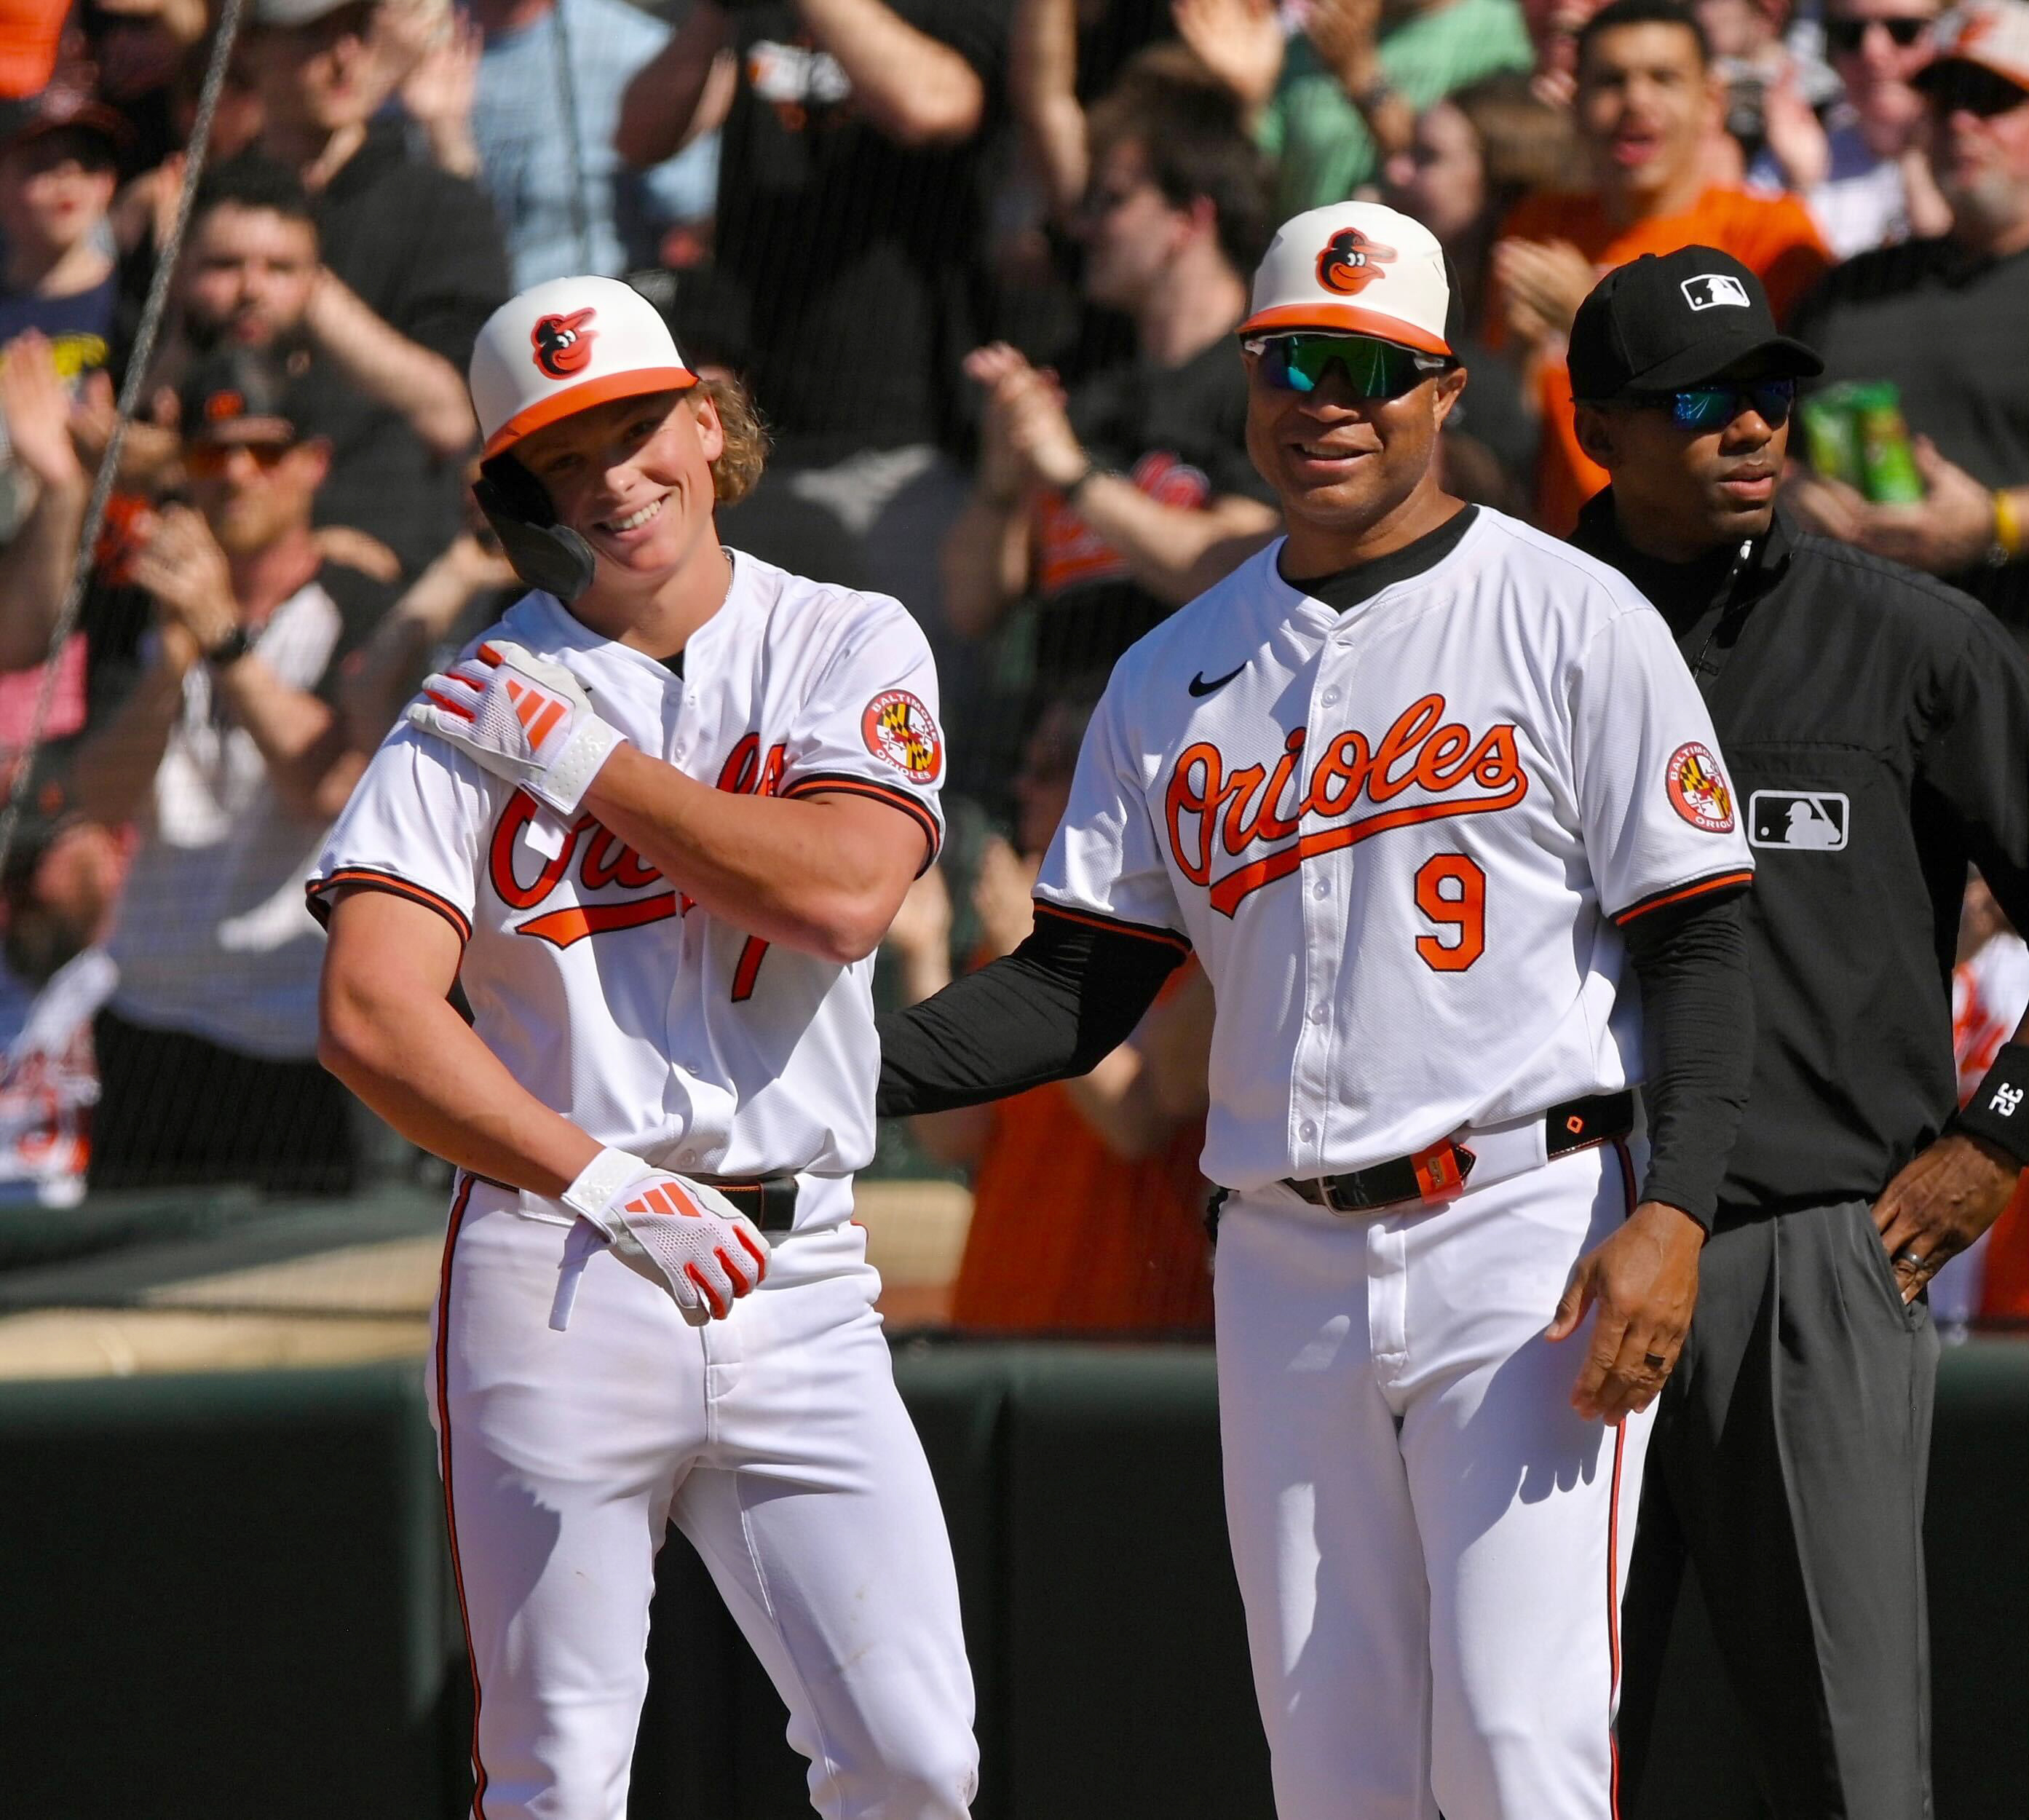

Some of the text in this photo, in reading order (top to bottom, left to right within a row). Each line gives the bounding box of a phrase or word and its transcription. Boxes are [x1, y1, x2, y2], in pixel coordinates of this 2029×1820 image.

[871, 693, 938, 742] BALTIMORE
[876, 748, 932, 780] ORIOLES
[1165, 693, 1528, 919] Orioles
[1415, 852, 1487, 973] 9
[1988, 1082, 2024, 1117] 32
